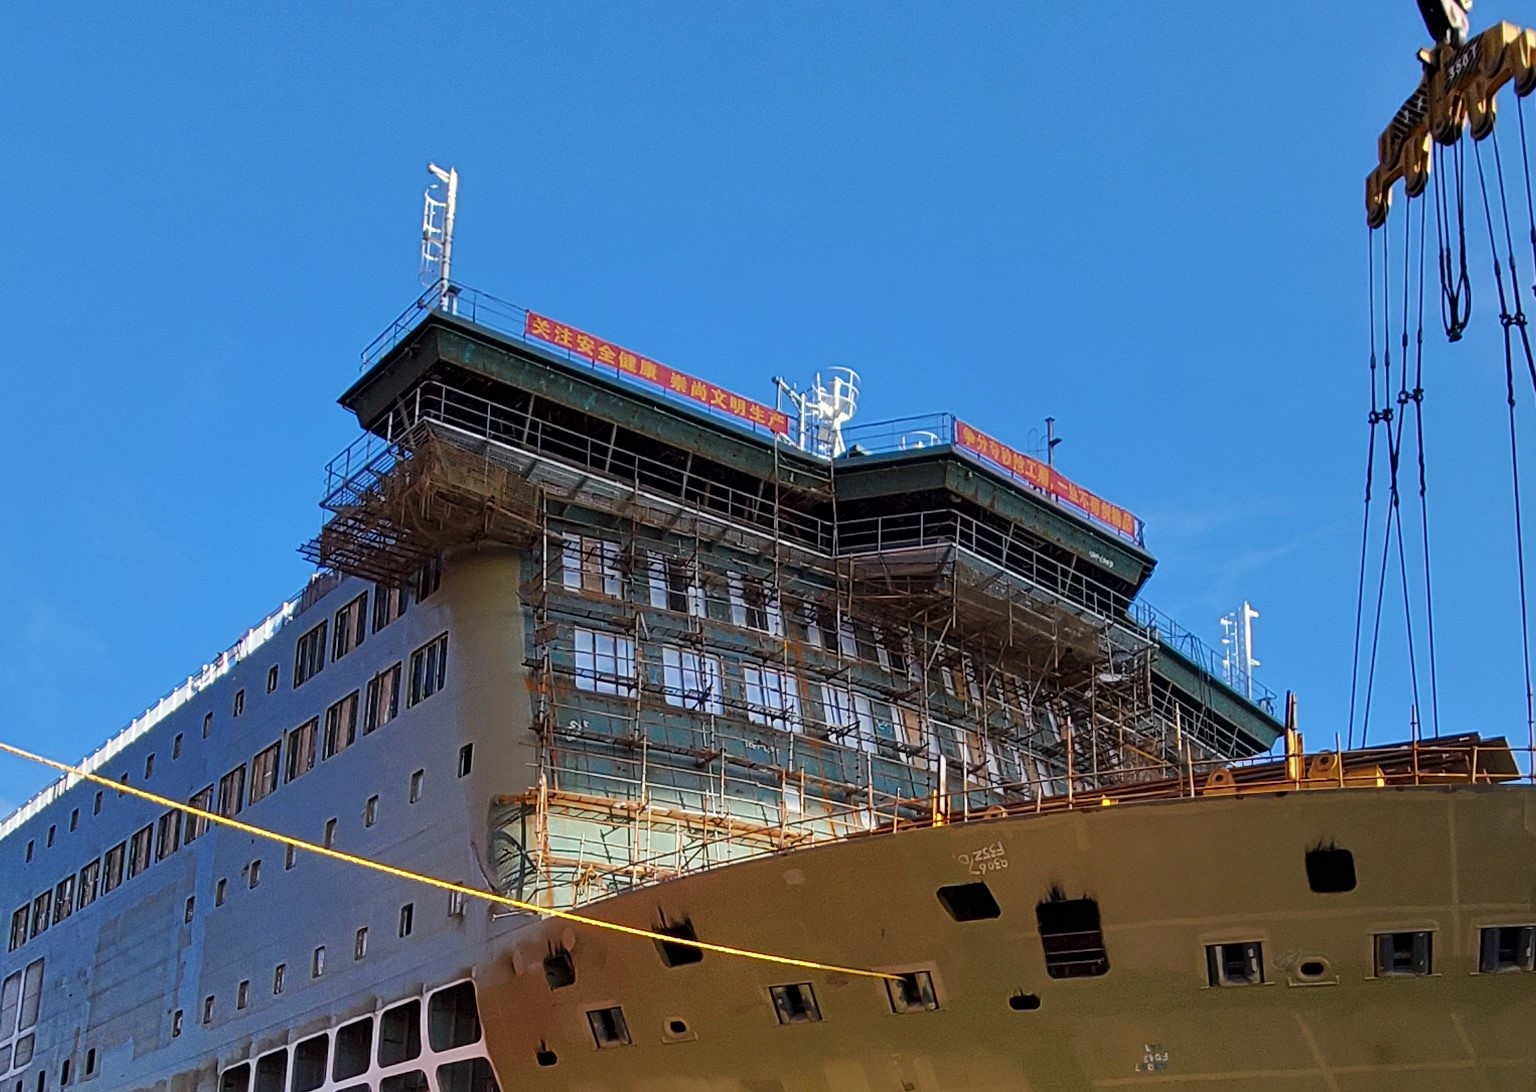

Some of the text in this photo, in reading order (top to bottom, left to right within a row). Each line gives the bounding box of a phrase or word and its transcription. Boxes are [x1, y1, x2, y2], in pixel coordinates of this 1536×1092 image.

[531, 316, 785, 429] 关注安全健康 崇尚文明生产
